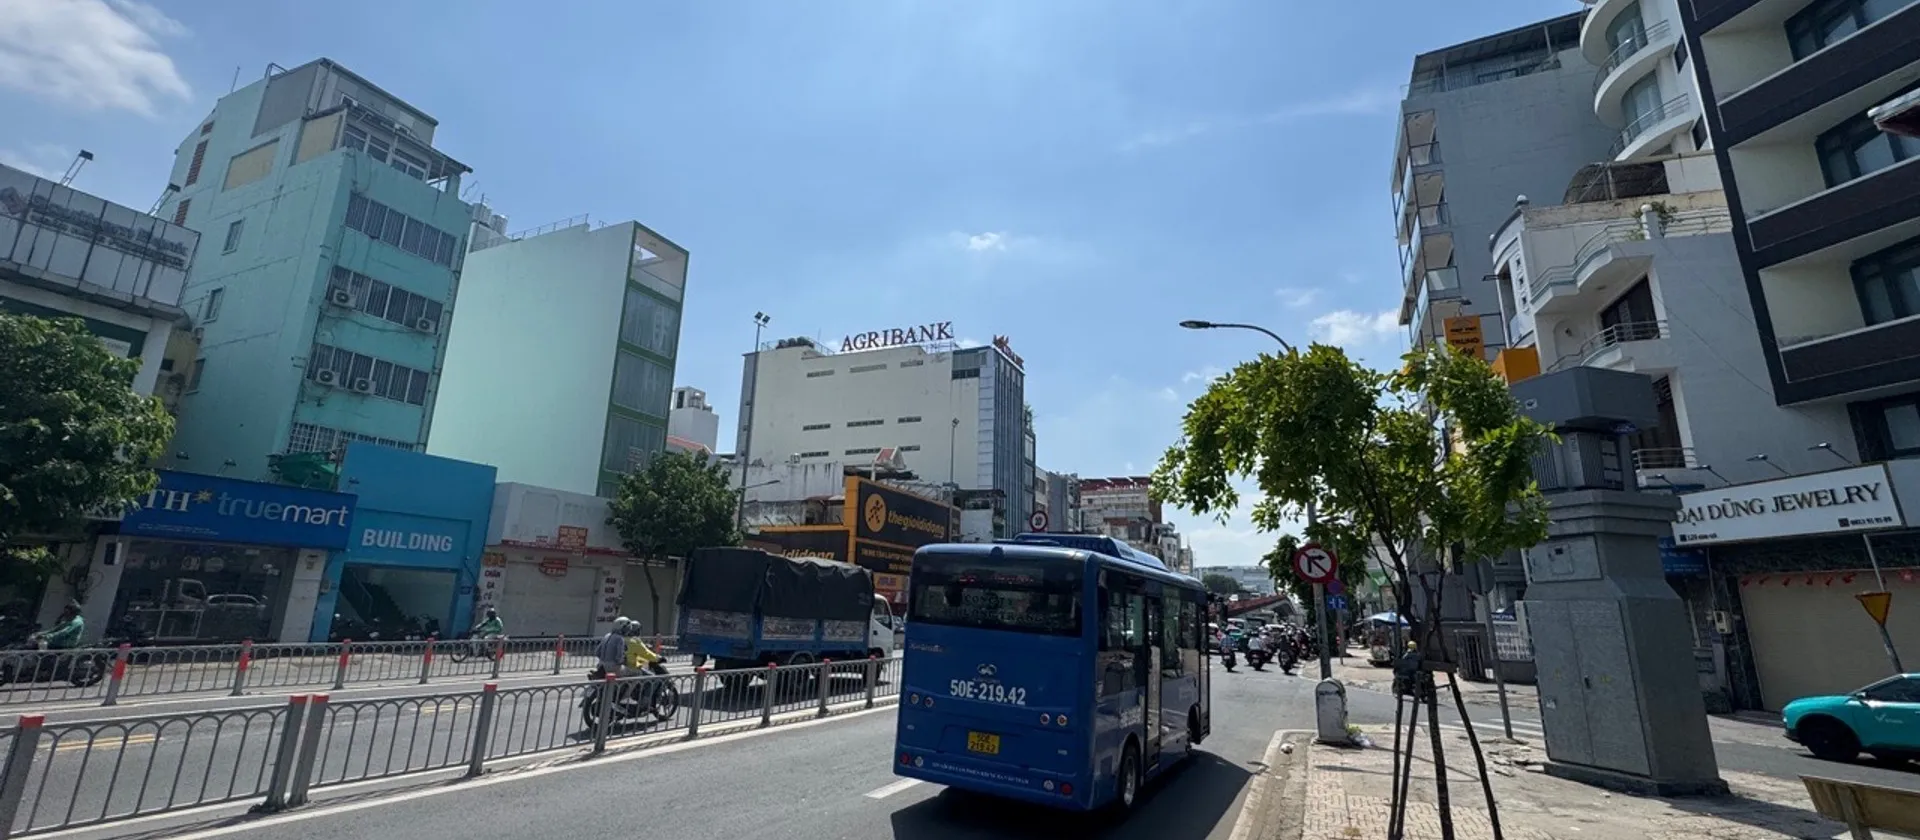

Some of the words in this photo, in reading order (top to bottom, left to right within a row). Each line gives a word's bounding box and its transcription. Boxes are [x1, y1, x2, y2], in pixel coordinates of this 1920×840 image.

[840, 321, 954, 353] AGRIBANK
[144, 488, 193, 513] TH
[217, 491, 349, 527] truemart
[1707, 498, 1765, 521] DŨNG
[1771, 482, 1881, 513] JEWELRY
[888, 510, 945, 539] thegioididong
[361, 529, 453, 552] BUILDING
[949, 679, 1026, 705] 50E-219.42
